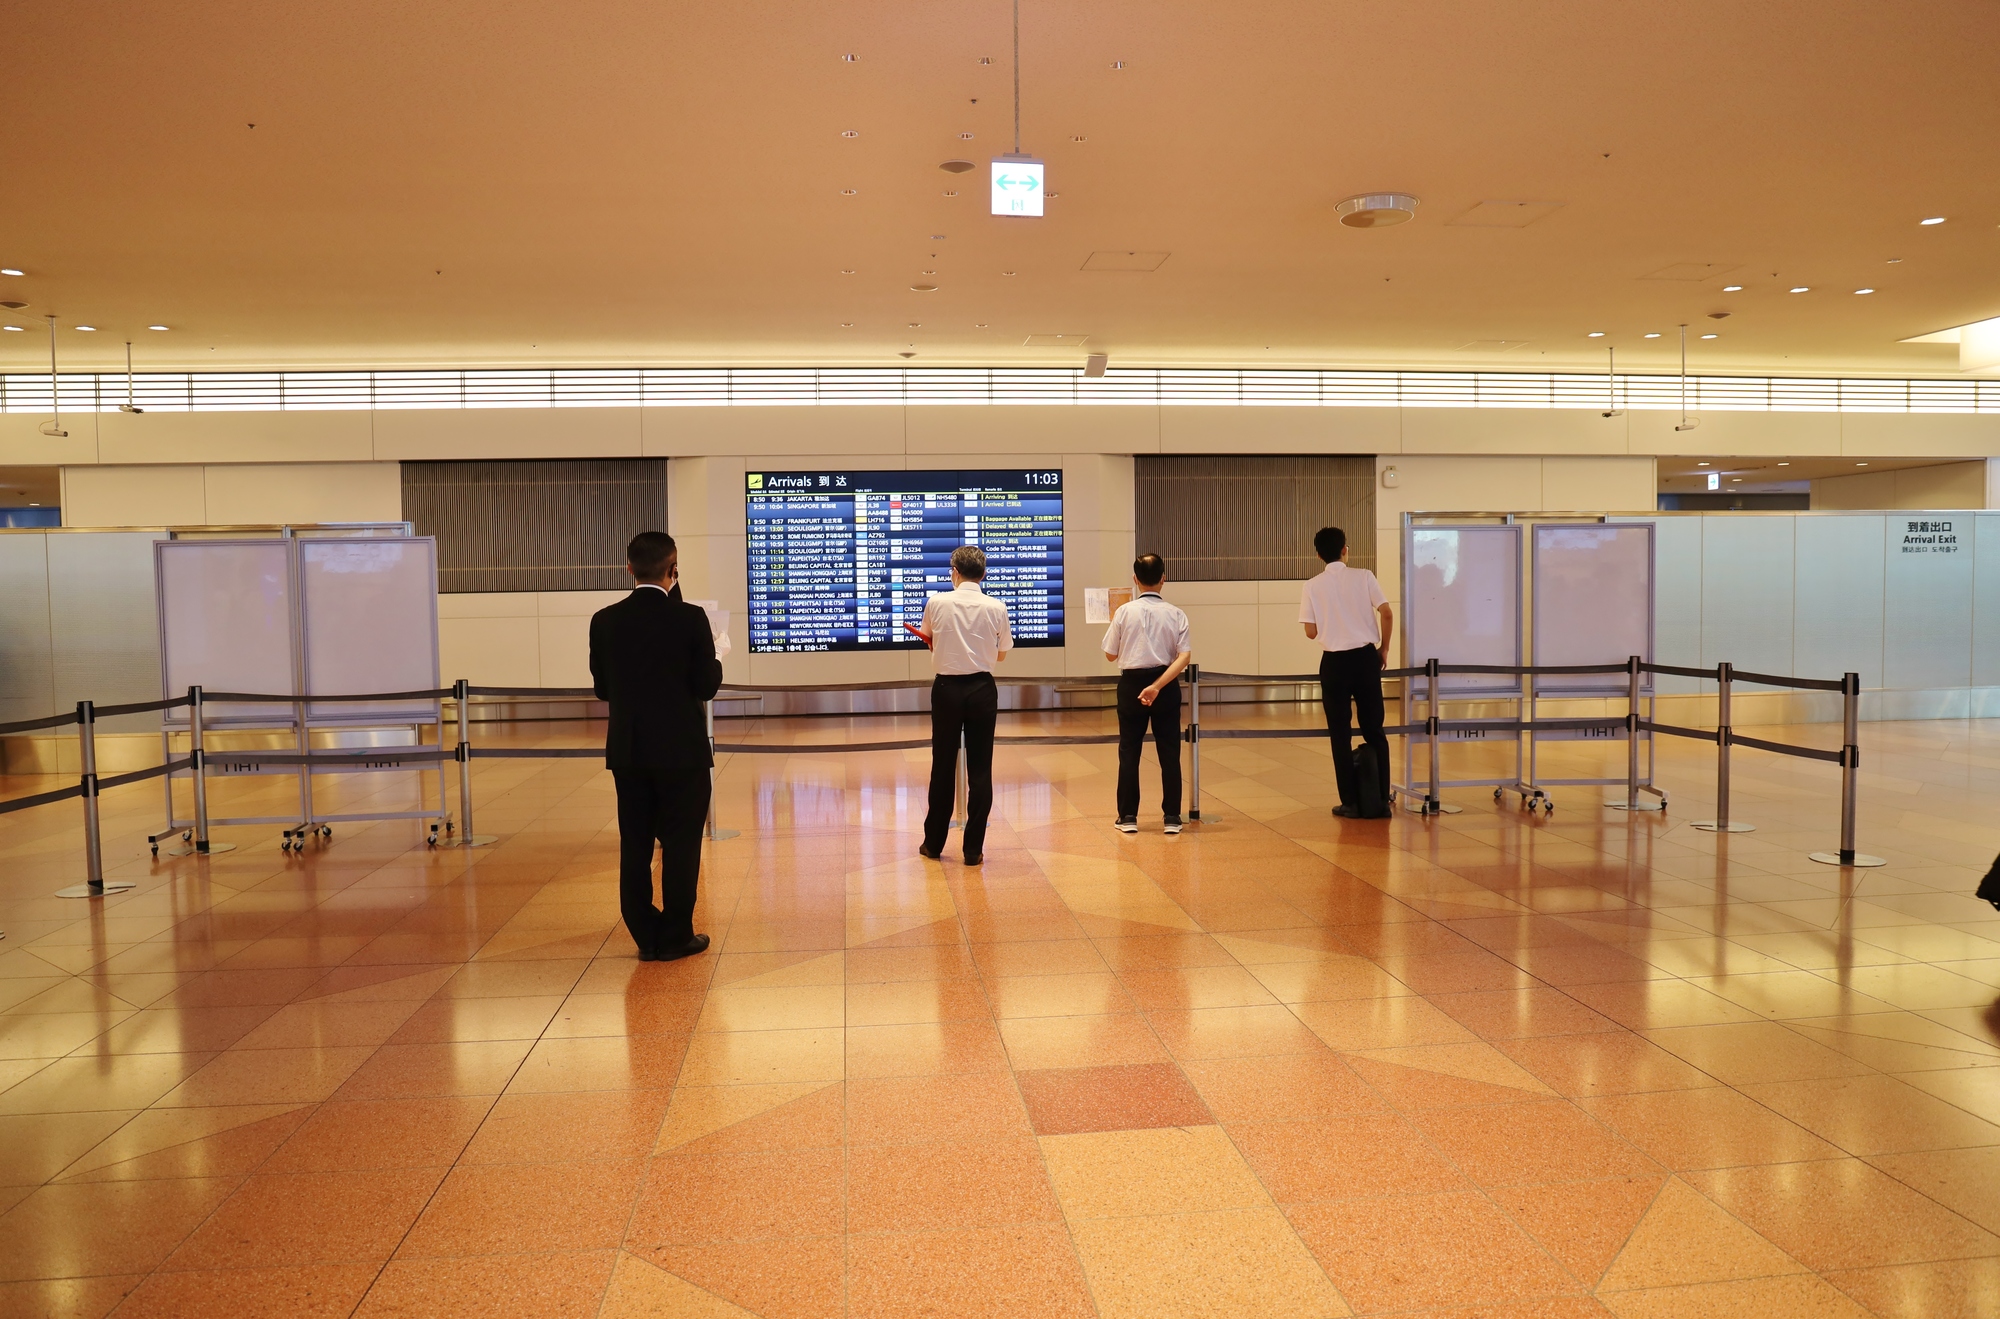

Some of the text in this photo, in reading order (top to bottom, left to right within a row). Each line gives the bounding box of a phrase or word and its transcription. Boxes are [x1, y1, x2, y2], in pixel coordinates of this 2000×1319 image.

[768, 476, 812, 487] Arrivals
[1024, 473, 1058, 484] 11:03
[1907, 521, 1952, 532] 到着出口
[1903, 535, 1957, 544] Arrival Exit
